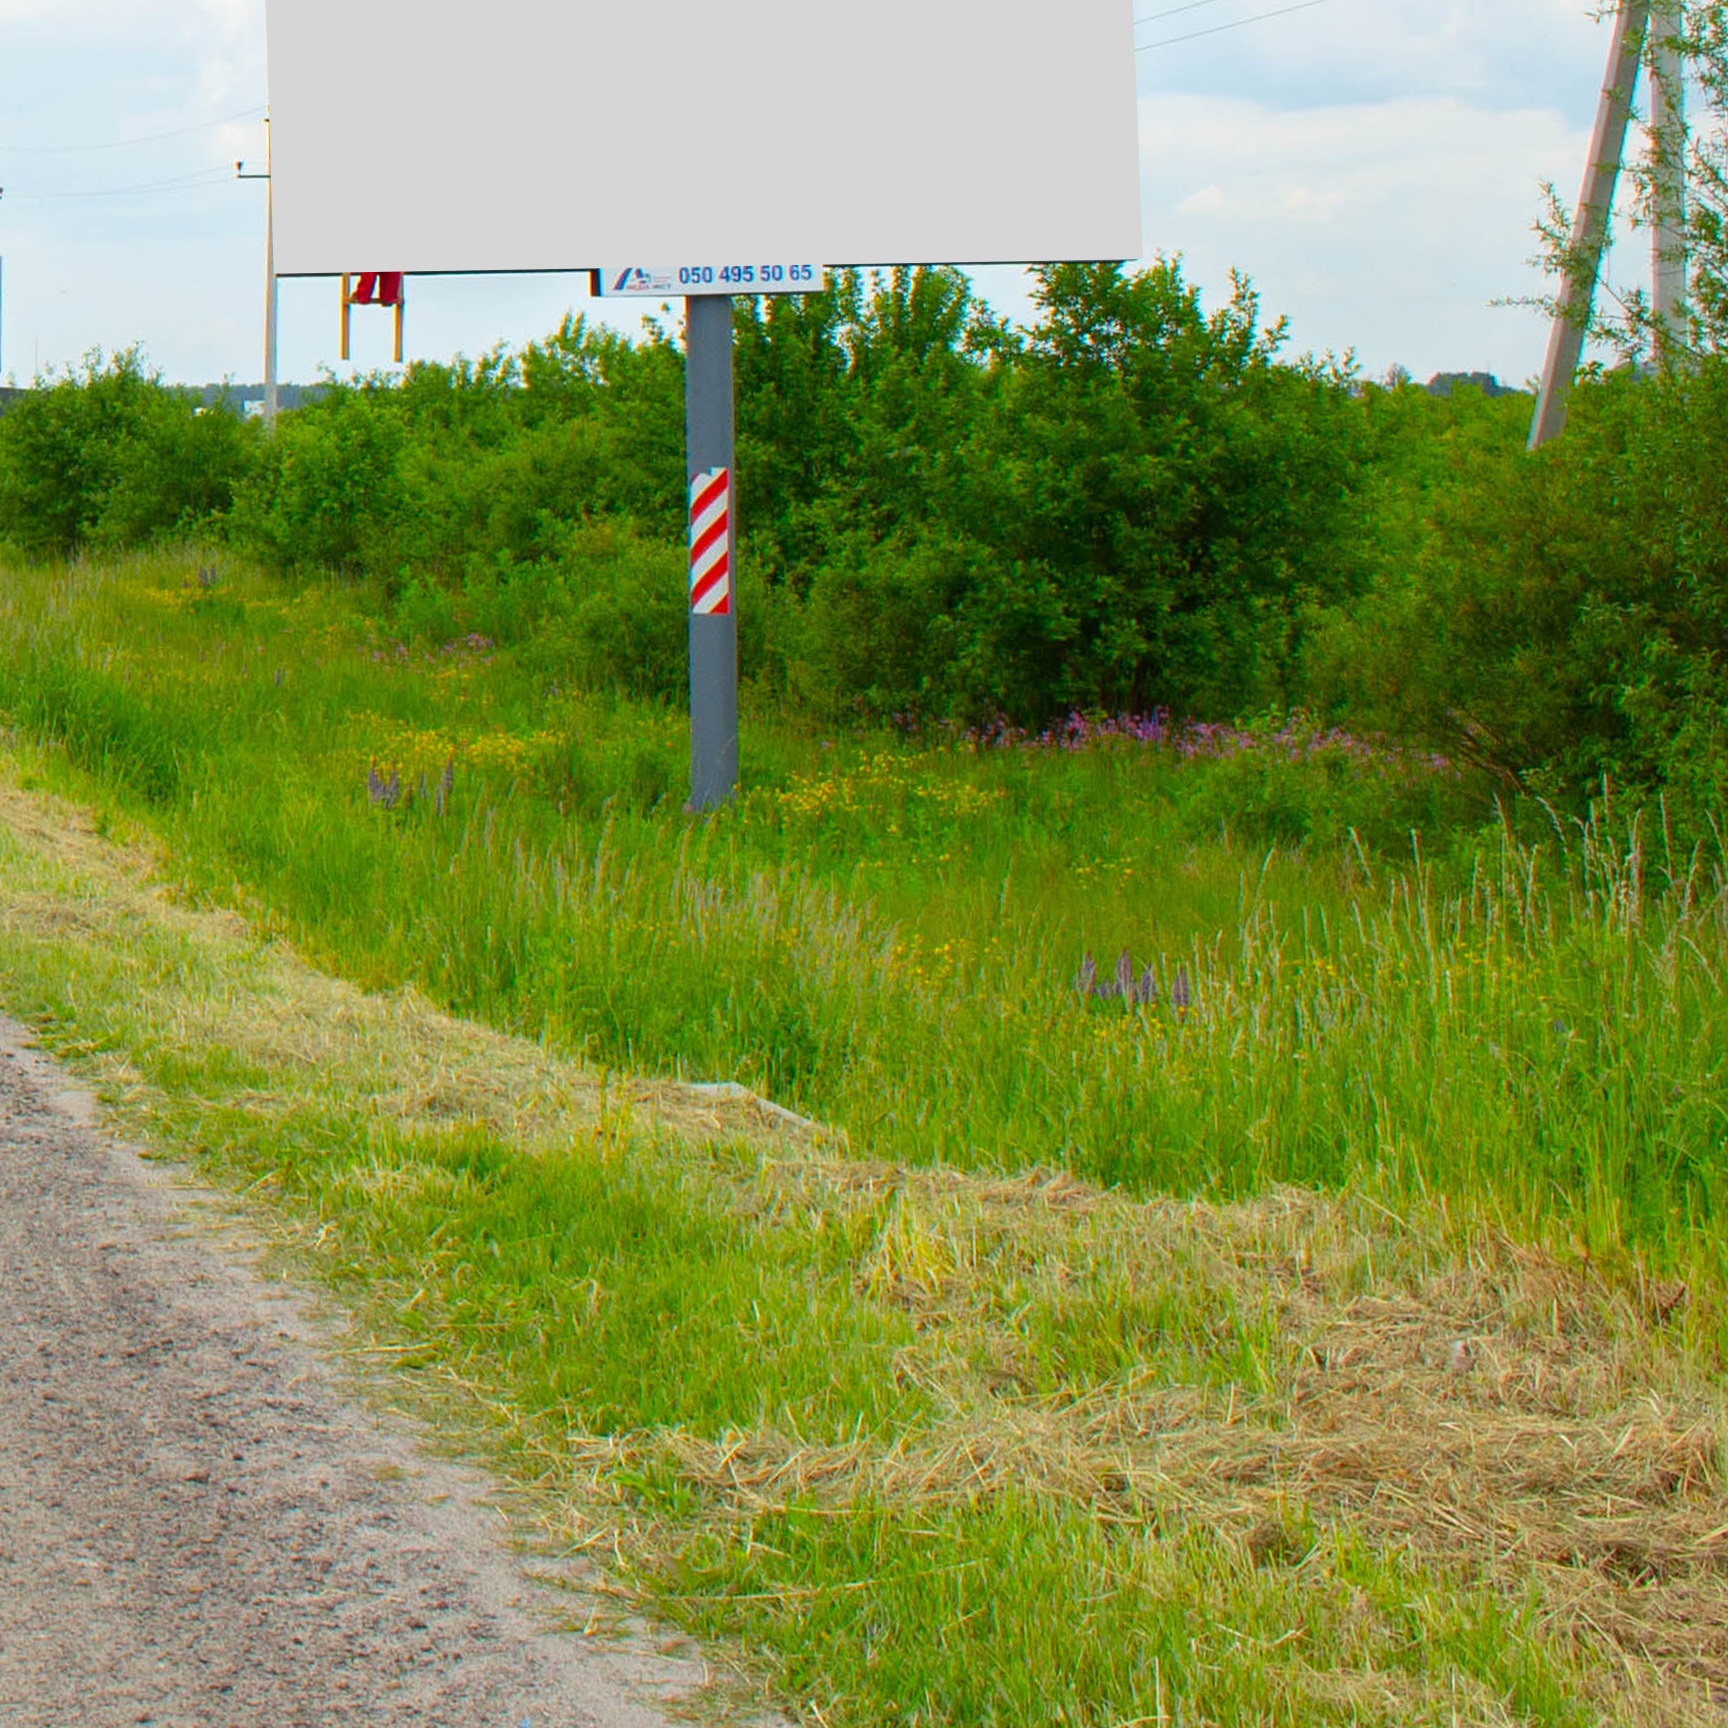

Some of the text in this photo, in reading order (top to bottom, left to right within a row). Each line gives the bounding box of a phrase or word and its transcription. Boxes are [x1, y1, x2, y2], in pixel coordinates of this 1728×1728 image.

[678, 264, 813, 284] 050 495 50 65
